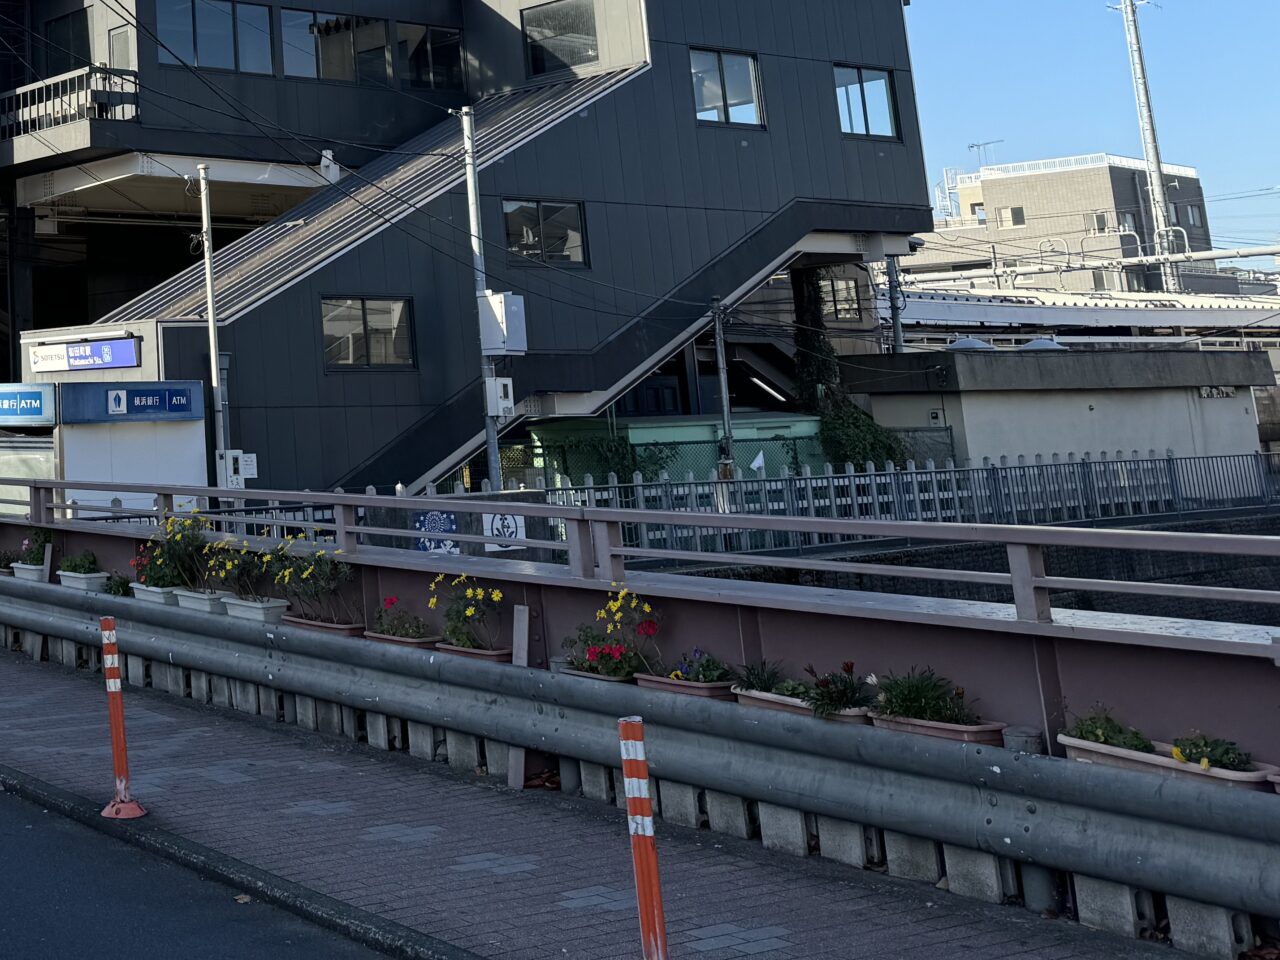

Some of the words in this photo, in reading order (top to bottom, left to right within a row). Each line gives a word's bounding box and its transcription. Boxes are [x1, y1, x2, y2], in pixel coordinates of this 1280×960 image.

[40, 353, 64, 361] SOTETSU
[20, 399, 40, 408] ATM
[134, 396, 160, 406] 横浜銀行
[172, 396, 187, 405] ATM
